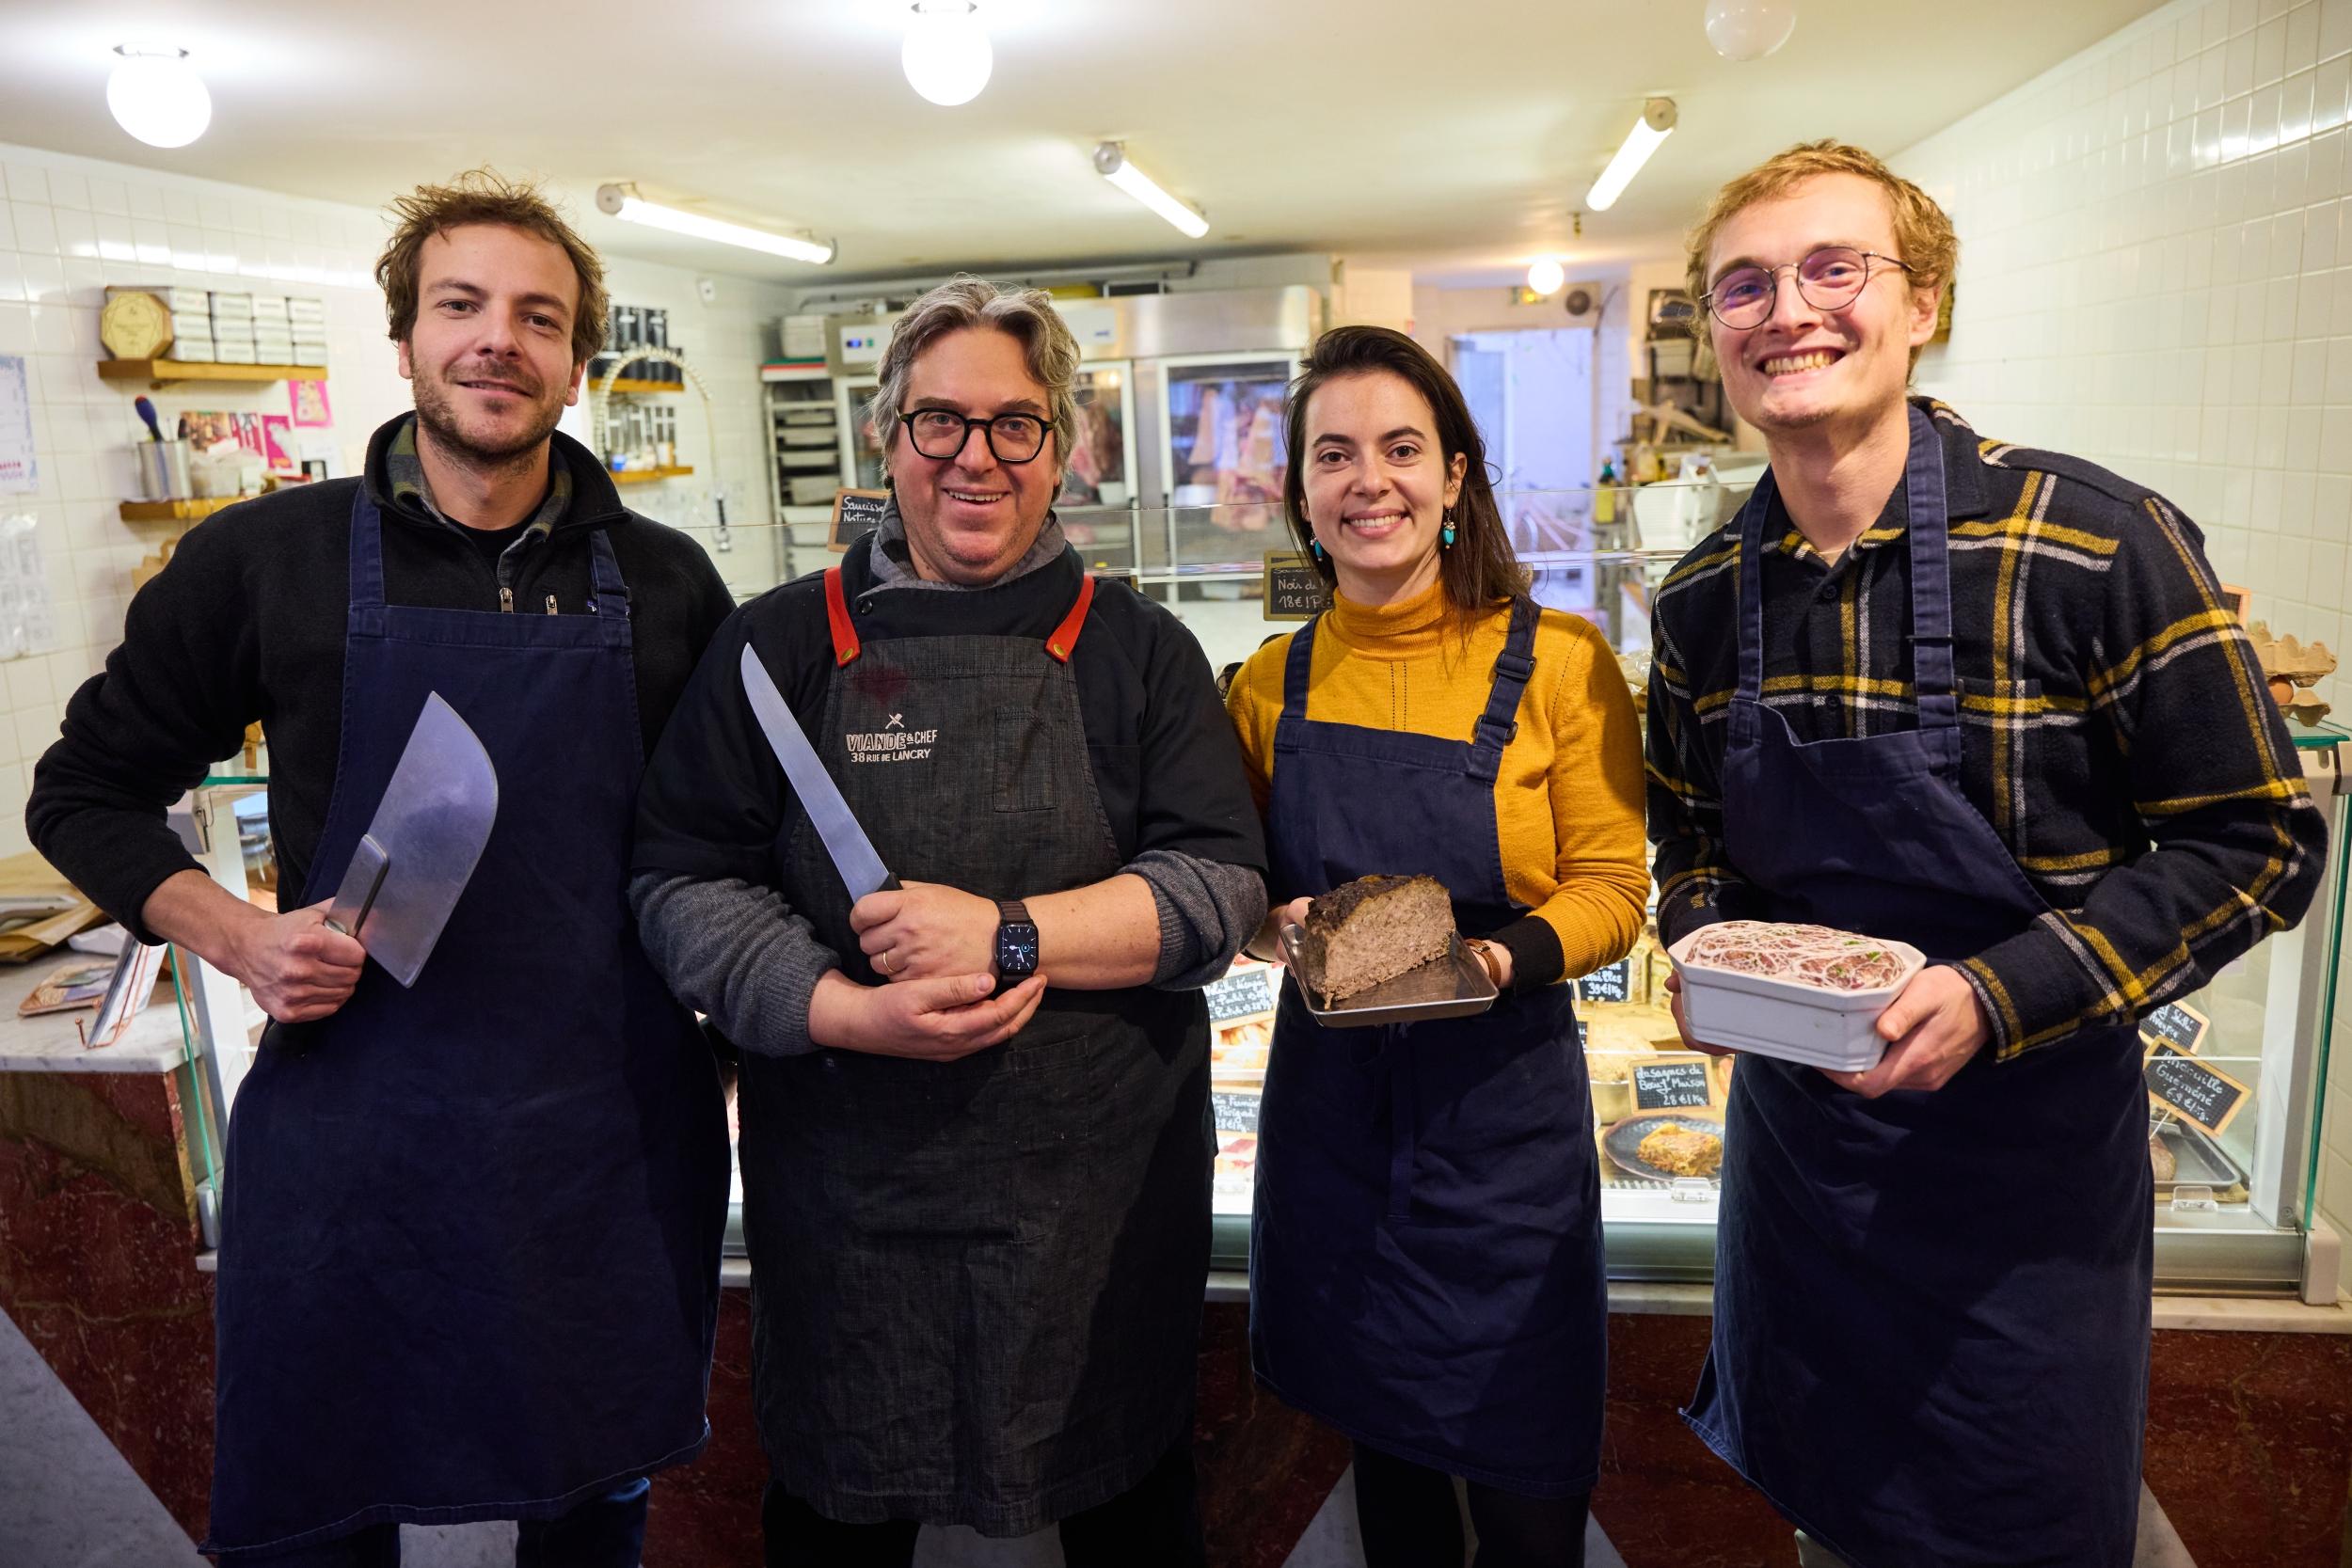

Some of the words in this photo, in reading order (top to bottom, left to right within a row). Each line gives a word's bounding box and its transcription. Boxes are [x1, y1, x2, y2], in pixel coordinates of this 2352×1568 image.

[1278, 578, 1303, 591] Noir
[846, 732, 907, 752] VIANDE
[914, 729, 938, 745] CHEF
[850, 752, 866, 763] 38
[866, 754, 880, 763] RUE
[892, 749, 931, 761] LANCRY
